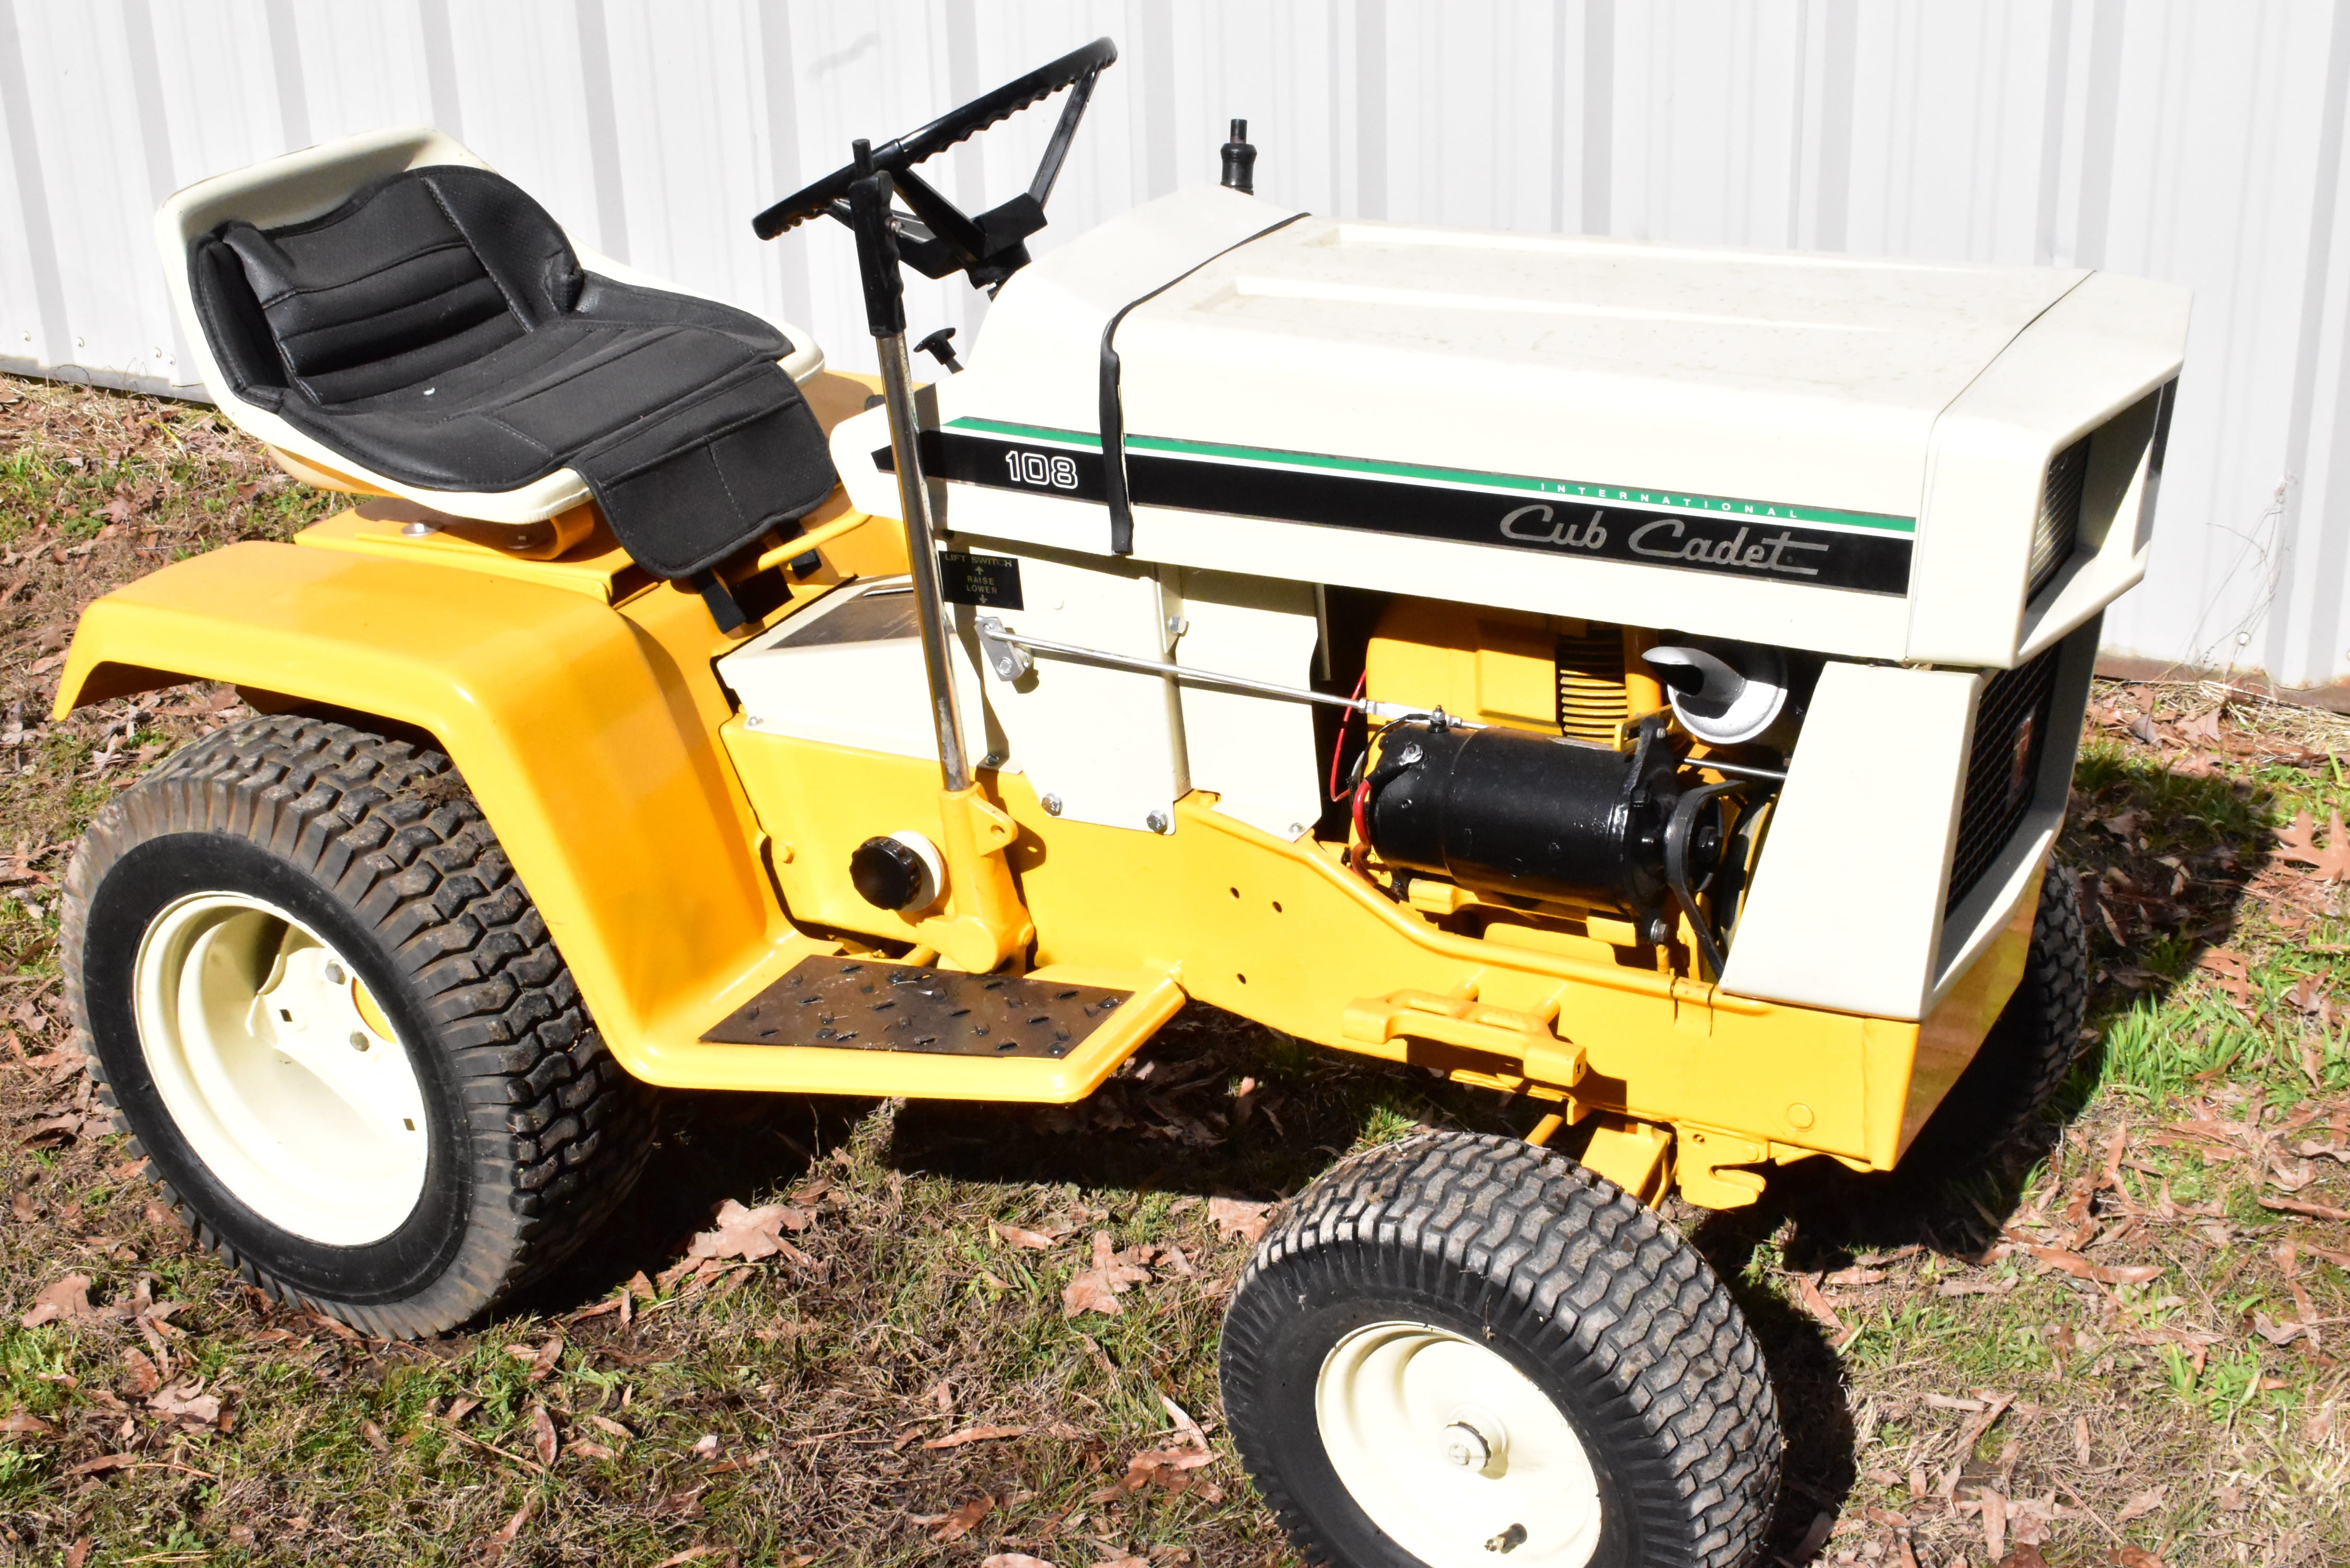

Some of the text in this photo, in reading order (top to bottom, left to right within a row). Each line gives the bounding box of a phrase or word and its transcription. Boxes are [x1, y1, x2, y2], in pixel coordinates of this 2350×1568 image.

[1005, 451, 1078, 489] 108
[1541, 483, 1797, 518] INTERNATIONAL
[1500, 504, 1829, 575] Cub Cadet
[945, 554, 966, 562] LIFT
[966, 584, 997, 594] LOWER
[967, 575, 995, 585] RAISE
